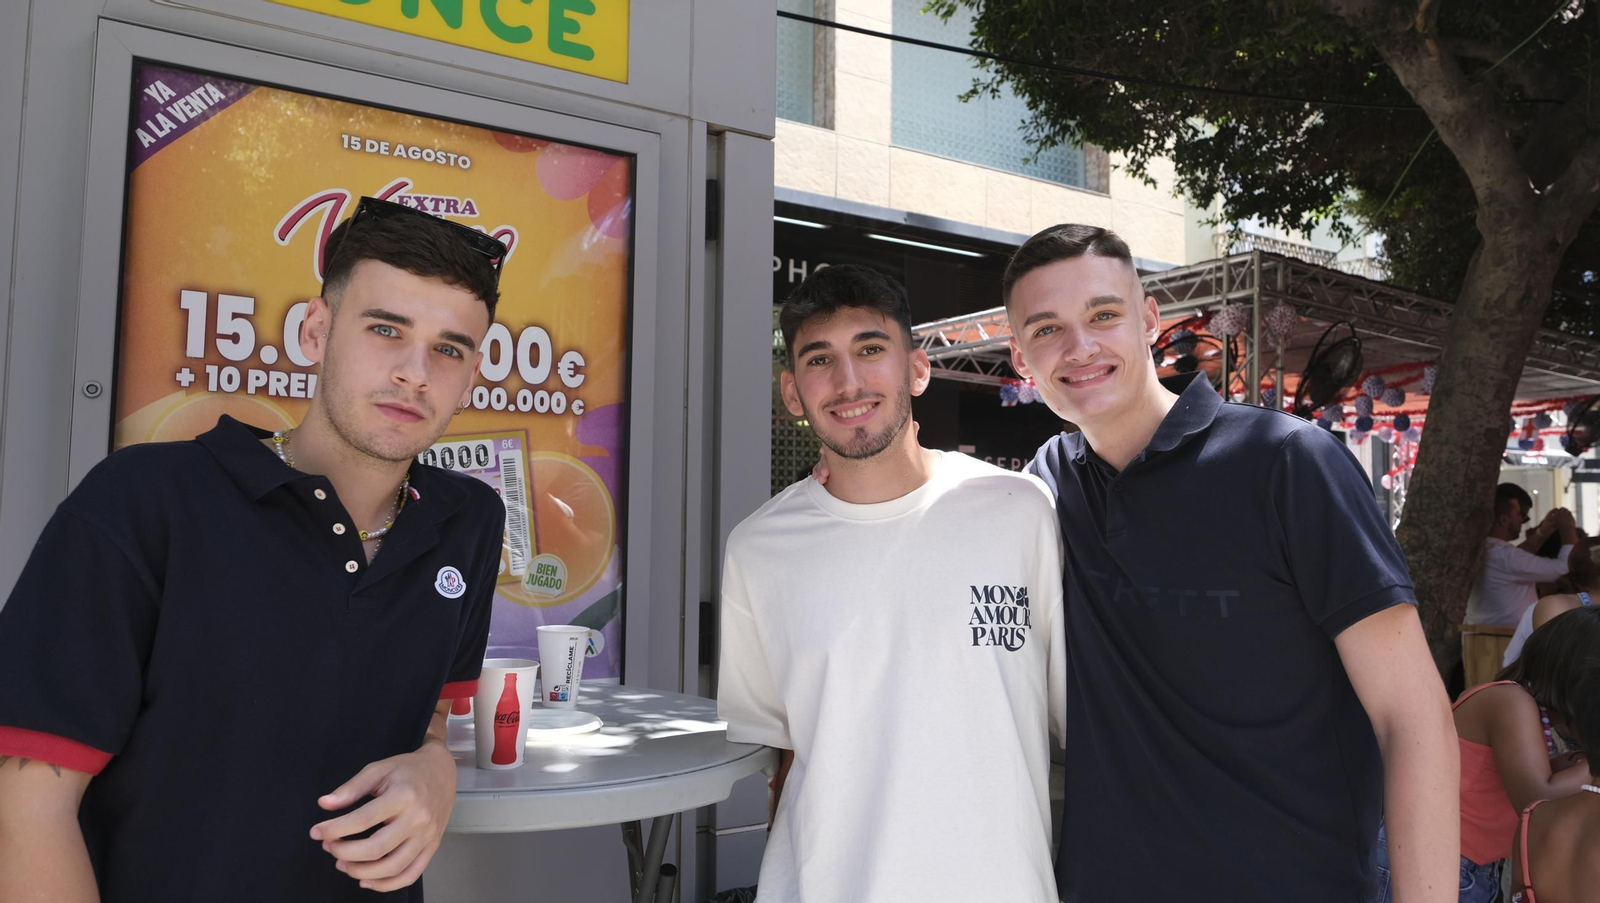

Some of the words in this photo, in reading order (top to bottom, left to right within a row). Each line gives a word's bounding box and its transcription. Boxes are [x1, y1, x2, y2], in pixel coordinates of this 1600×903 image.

[143, 80, 178, 105] YA
[166, 82, 226, 124] VENTA
[145, 112, 178, 139] LA
[134, 128, 157, 149] A
[341, 134, 362, 151] 15
[365, 139, 390, 155] DE
[393, 144, 472, 169] AGOSTO
[397, 195, 477, 216] EXTRA
[205, 364, 241, 393] 10
[525, 573, 563, 590] JUGADO
[536, 562, 558, 577] BIEN
[969, 584, 1018, 605] MON
[968, 605, 1032, 630] AMOUR
[971, 626, 1026, 652] PARIS
[565, 646, 575, 684] RECÍCLAME
